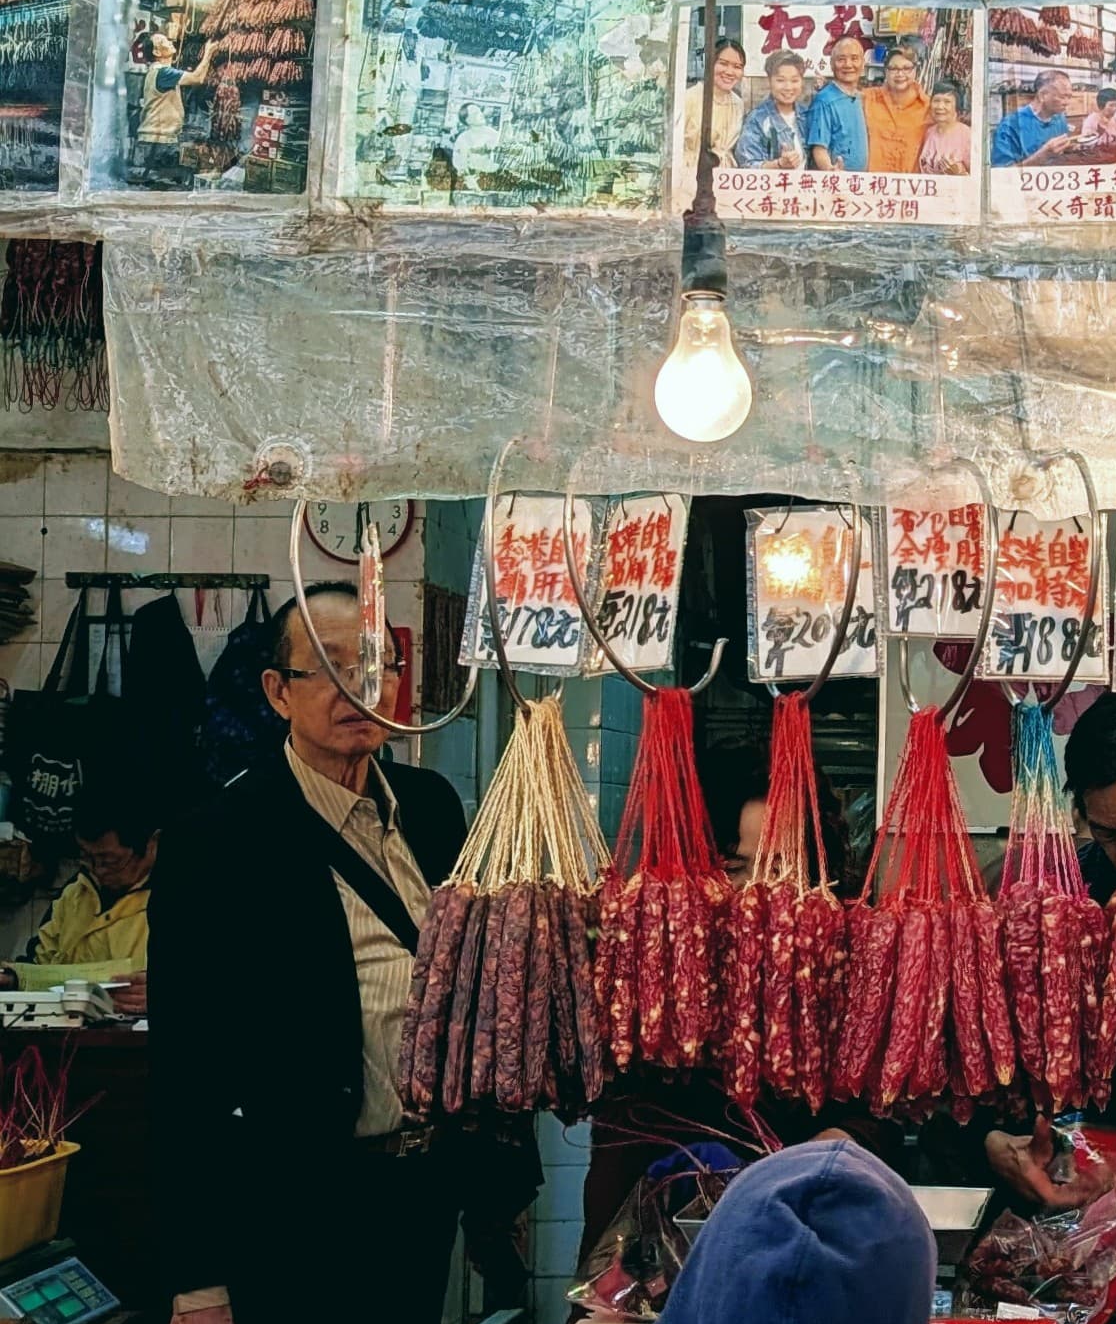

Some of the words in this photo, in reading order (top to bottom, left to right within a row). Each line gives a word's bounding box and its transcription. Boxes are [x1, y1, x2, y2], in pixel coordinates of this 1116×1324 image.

[718, 173, 938, 197] 2023年無線電視TVB
[733, 197, 919, 220] <<奇蹟小店>>訪問
[317, 502, 328, 516] 9
[391, 505, 402, 520] 3
[319, 520, 330, 535] 8
[335, 536, 346, 550] 7
